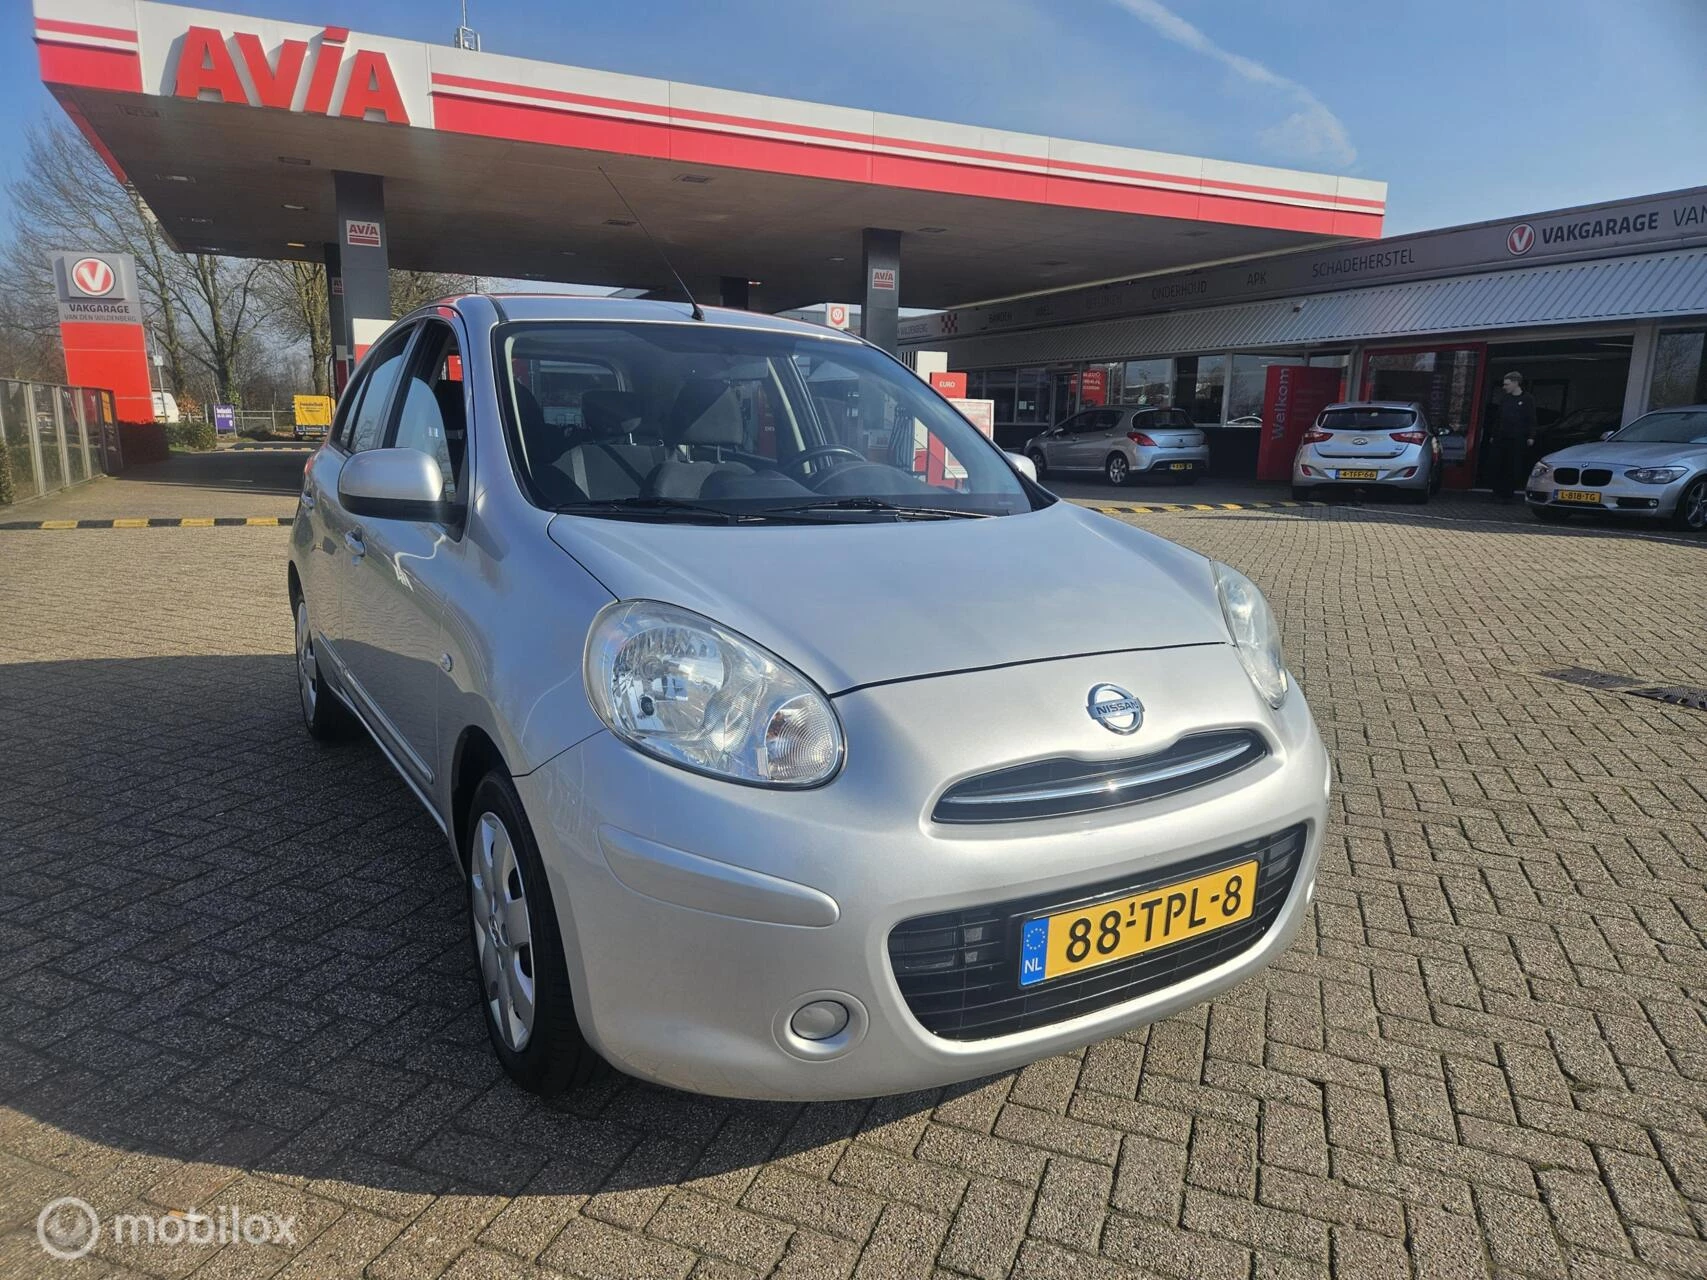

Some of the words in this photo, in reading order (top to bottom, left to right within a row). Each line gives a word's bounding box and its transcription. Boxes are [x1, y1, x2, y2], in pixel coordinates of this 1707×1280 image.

[349, 223, 378, 236] AVIA
[1542, 212, 1659, 244] VAKGARAGE
[1311, 248, 1415, 279] SCHADEHERSTEL
[1247, 271, 1267, 286] APK
[1151, 280, 1207, 300] ONDERHOUD
[69, 303, 130, 314] VAKGARAGE
[1272, 368, 1289, 440] Welkom
[1096, 701, 1139, 715] NISSAN
[1024, 957, 1043, 974] NL
